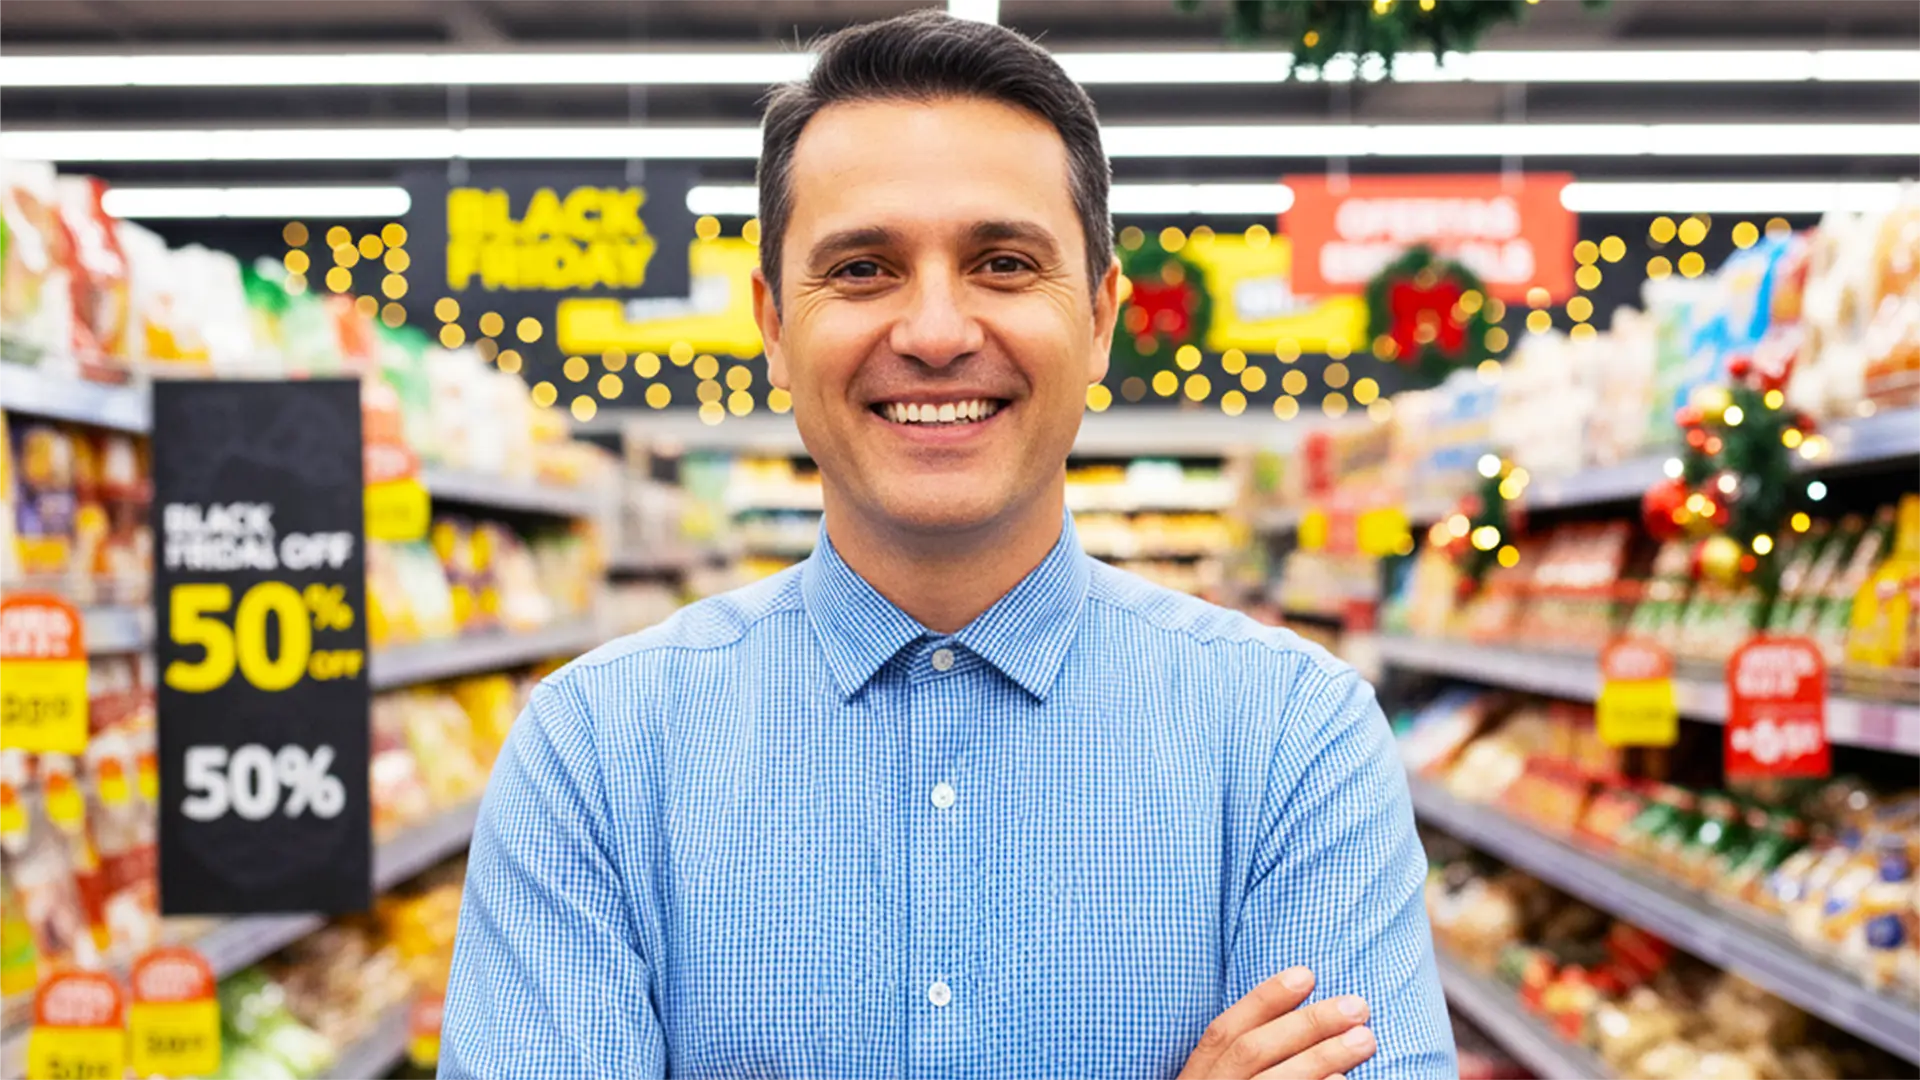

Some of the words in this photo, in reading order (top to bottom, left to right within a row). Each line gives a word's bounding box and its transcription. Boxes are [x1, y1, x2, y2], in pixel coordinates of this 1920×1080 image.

[446, 186, 648, 238] BLACK
[446, 236, 657, 290] FRIDAY
[164, 502, 275, 537] BLACK
[280, 531, 354, 571] OFF
[307, 649, 364, 680] OFF
[180, 743, 346, 822] 50%
